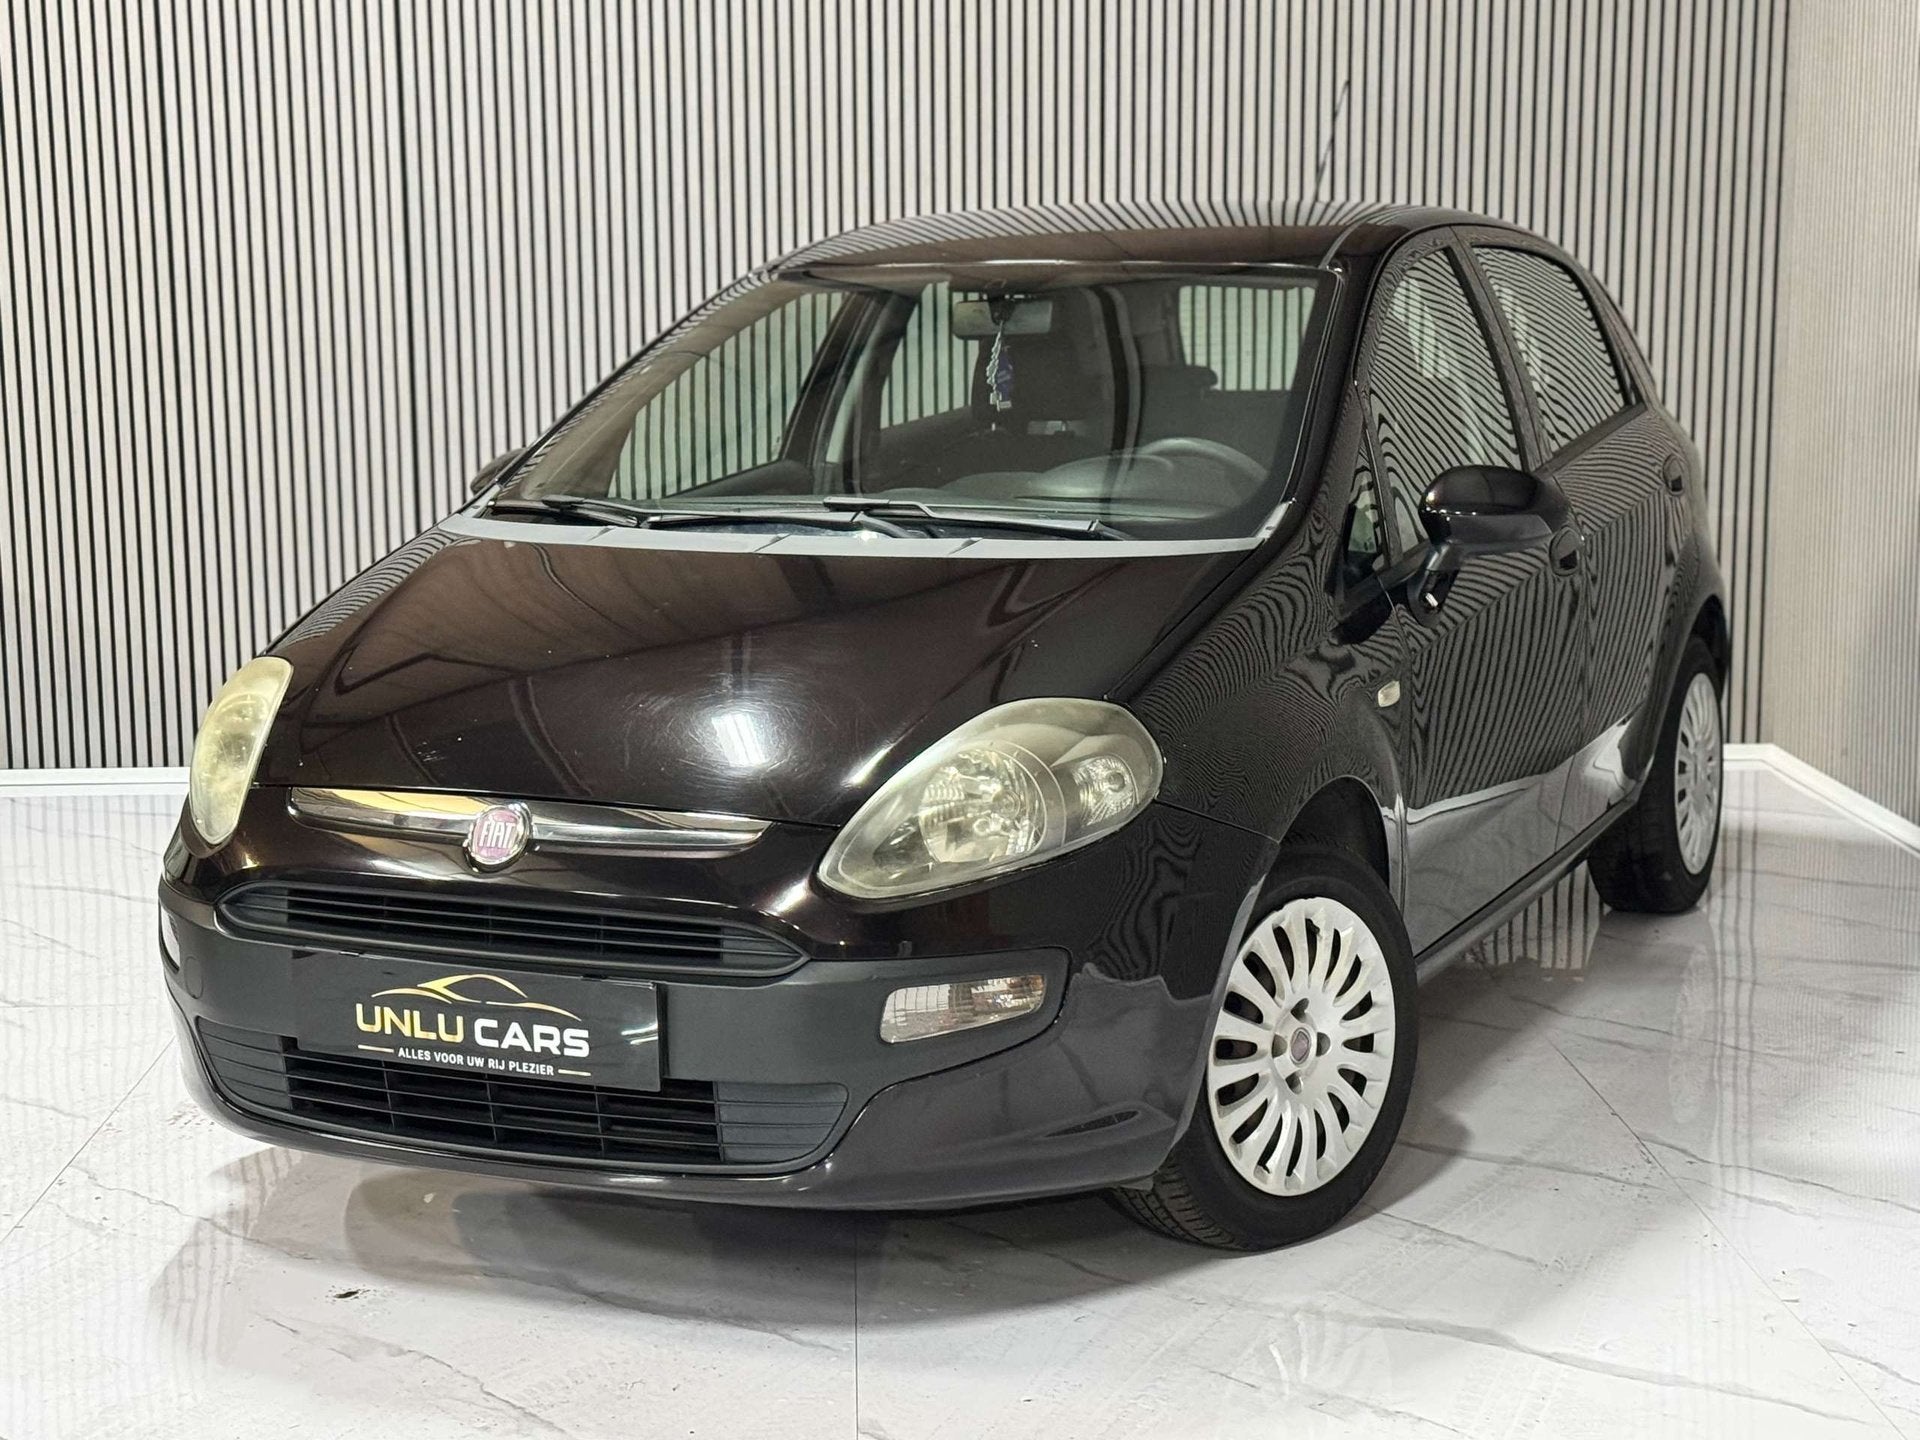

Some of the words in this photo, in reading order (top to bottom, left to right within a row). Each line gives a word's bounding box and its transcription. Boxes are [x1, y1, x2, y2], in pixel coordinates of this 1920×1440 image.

[479, 820, 515, 848] FIAT
[356, 1003, 464, 1043] UNLU
[474, 1018, 590, 1058] CARS
[398, 1047, 431, 1062] ALLES
[434, 1052, 464, 1066] VOOR
[466, 1055, 485, 1068] UW
[488, 1058, 505, 1071] RIJ
[508, 1061, 554, 1076] PLEZIER
